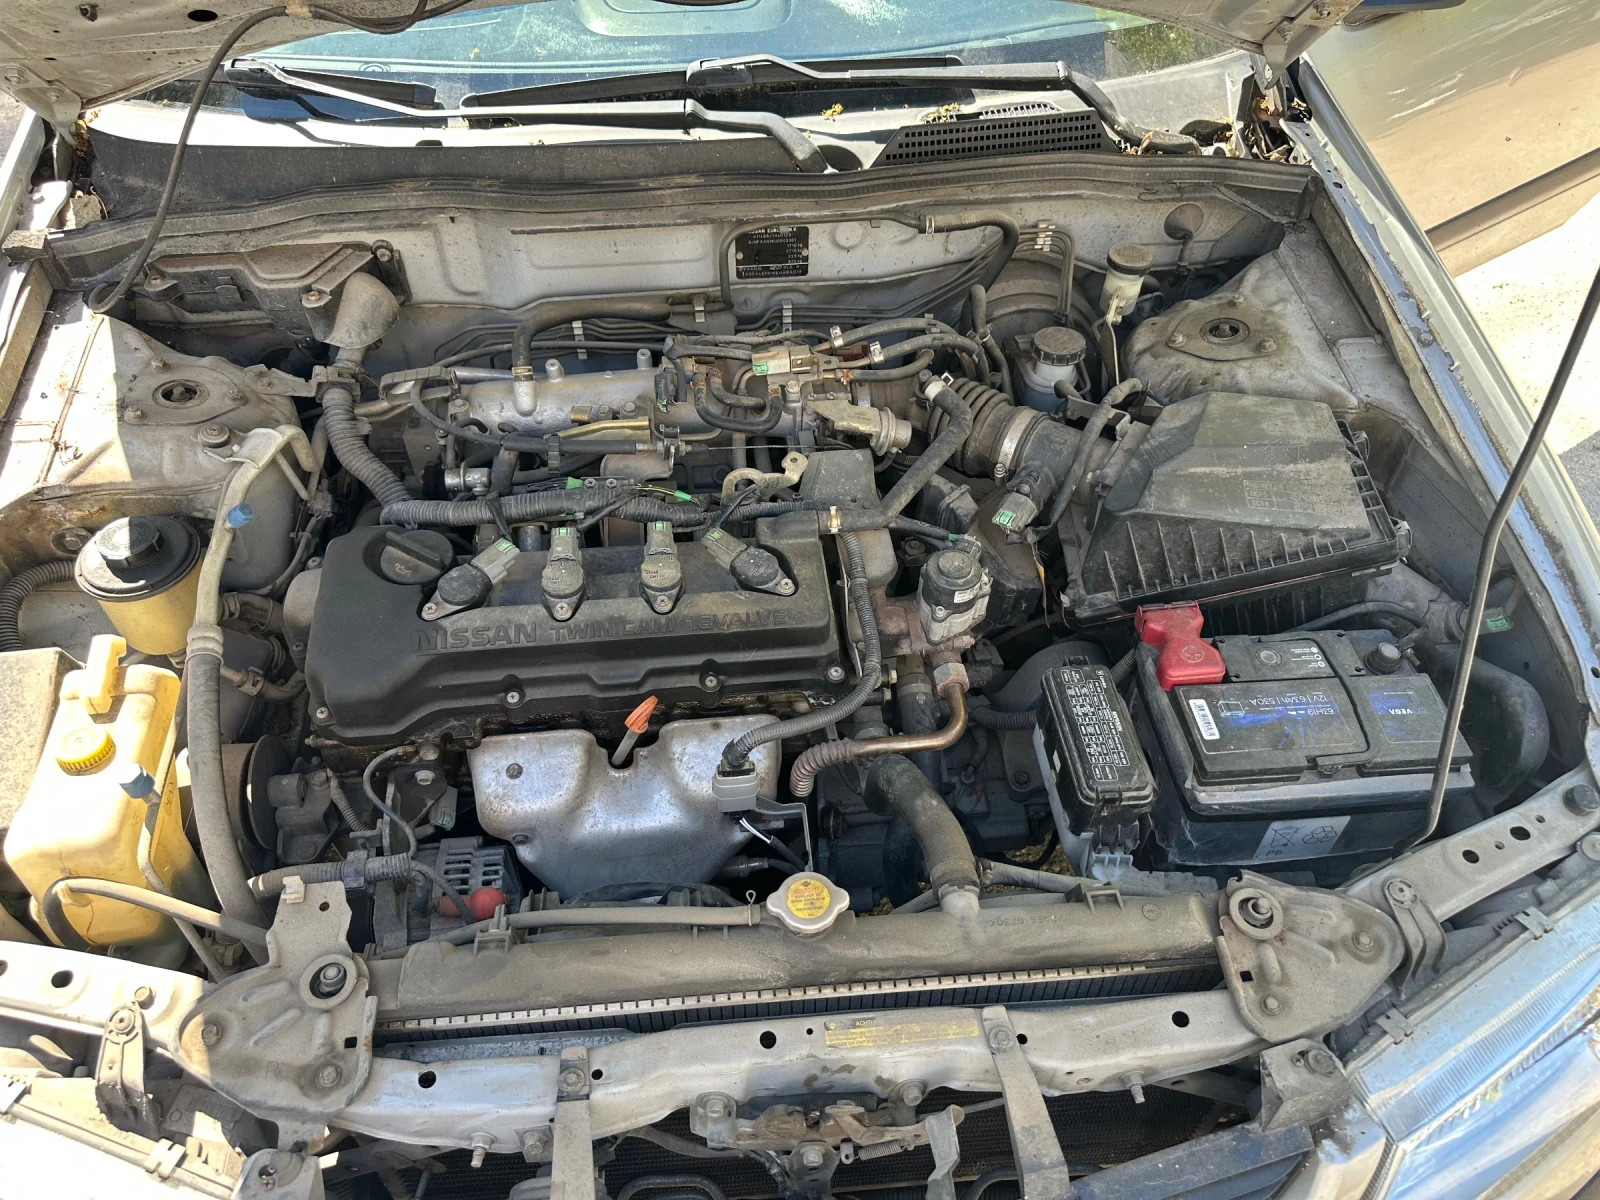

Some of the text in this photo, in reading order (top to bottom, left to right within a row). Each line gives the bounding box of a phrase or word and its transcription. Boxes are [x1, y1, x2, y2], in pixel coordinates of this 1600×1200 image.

[412, 622, 537, 653] NISSAN
[550, 620, 613, 641] TWIN
[622, 616, 675, 636] CAM
[1266, 849, 1283, 857] Pb
